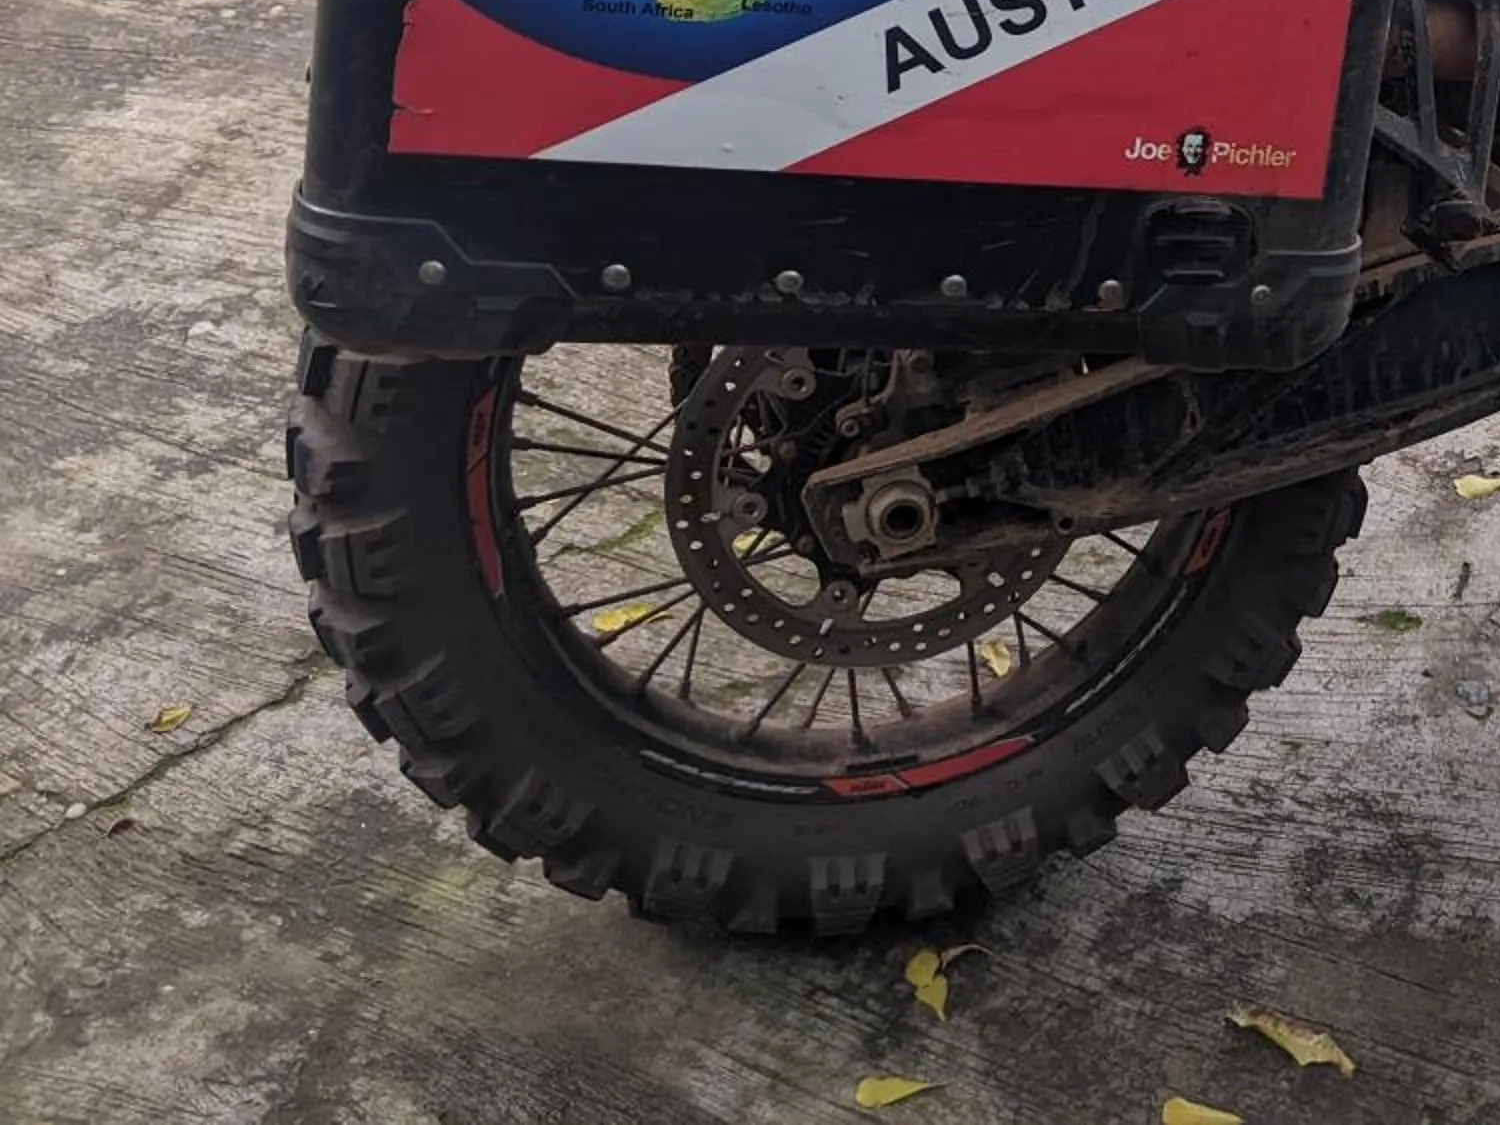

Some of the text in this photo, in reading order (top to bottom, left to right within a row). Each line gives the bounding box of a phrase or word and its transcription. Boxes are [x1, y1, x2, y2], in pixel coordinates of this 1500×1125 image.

[641, 1, 694, 20] Africa
[1124, 136, 1297, 168] Joe Pichler
